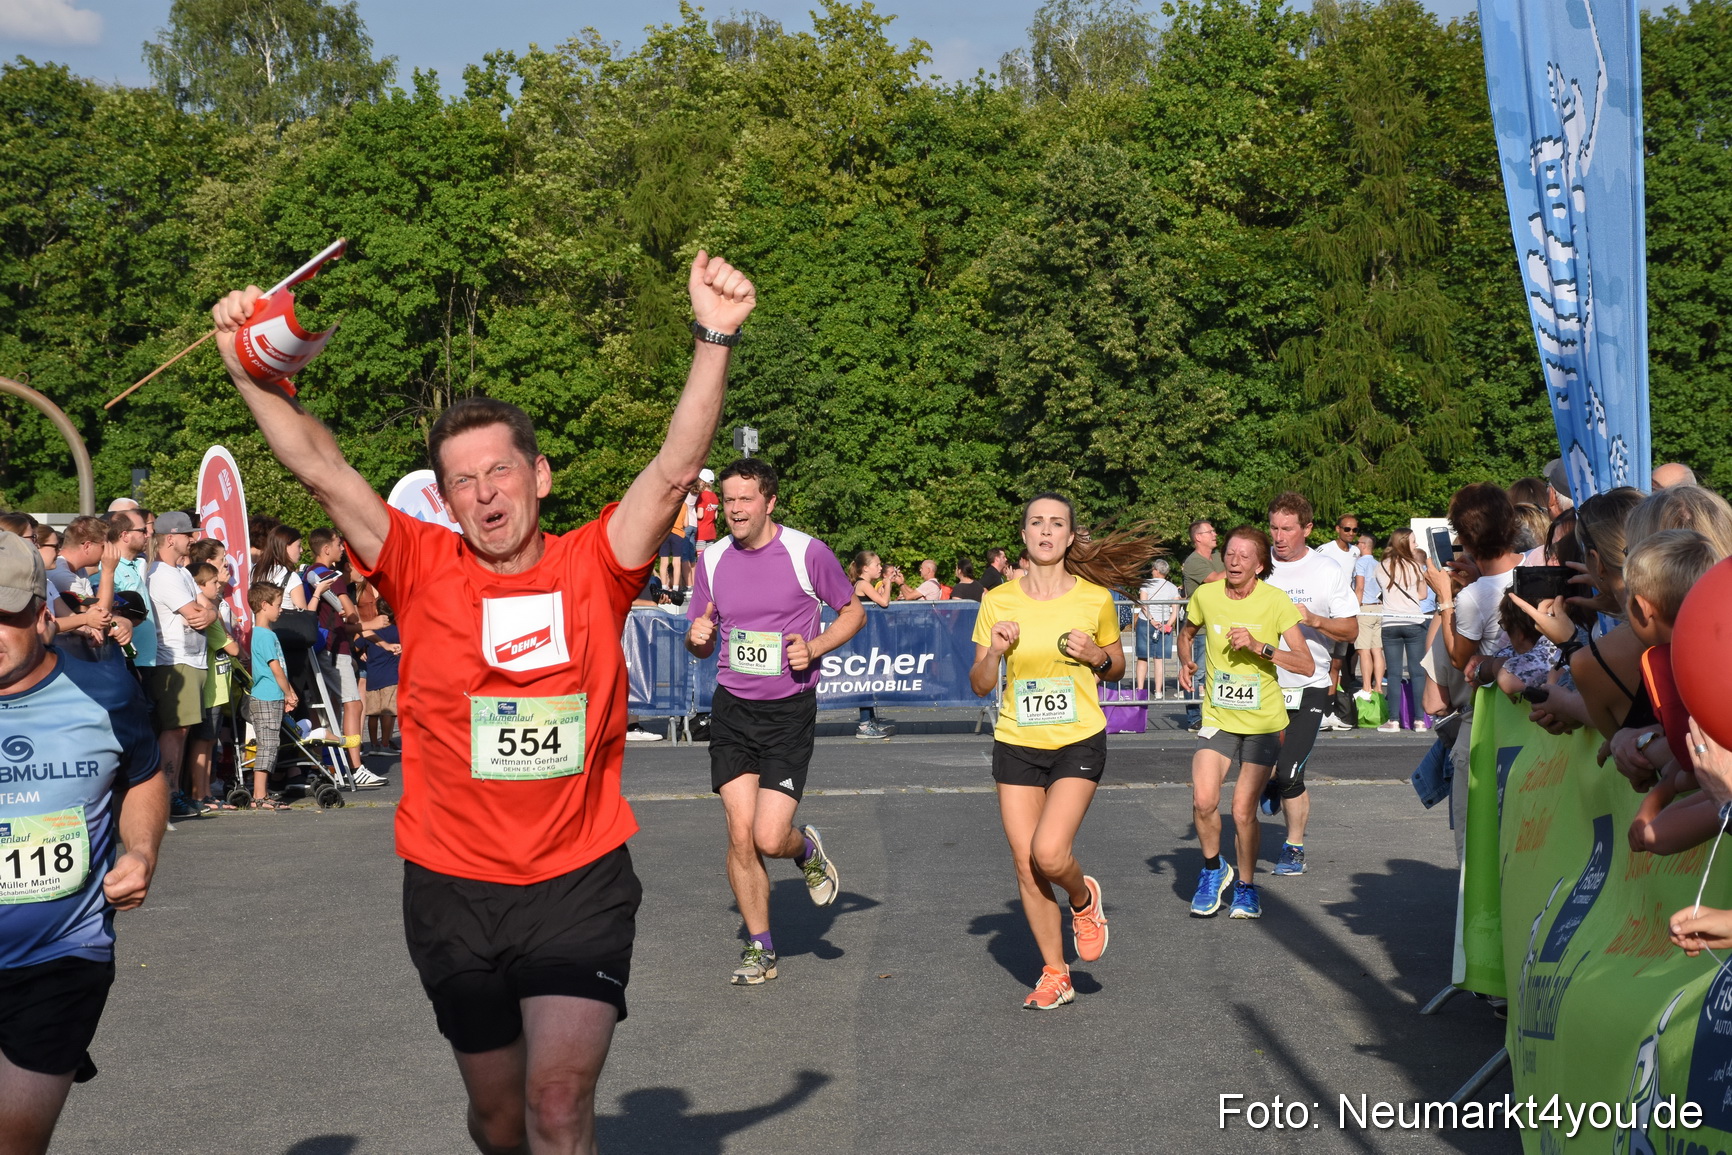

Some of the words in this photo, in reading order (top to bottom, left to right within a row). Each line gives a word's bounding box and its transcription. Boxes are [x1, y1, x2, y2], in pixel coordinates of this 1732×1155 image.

[243, 328, 255, 358] DEHN
[511, 636, 537, 655] DEHN
[737, 645, 767, 663] 630
[820, 647, 934, 677] scher
[817, 679, 922, 693] UTOMOBILE
[1218, 684, 1254, 699] 1244
[1022, 694, 1068, 712] 1763
[560, 716, 579, 725] 2019
[497, 726, 561, 756] 554
[490, 757, 532, 766] Wittmann
[534, 755, 568, 765] Gerhard
[0, 791, 40, 805] TEAM
[60, 831, 80, 841] 2019
[0, 843, 74, 879] 118
[0, 880, 28, 889] Müller
[31, 877, 60, 887] Martin
